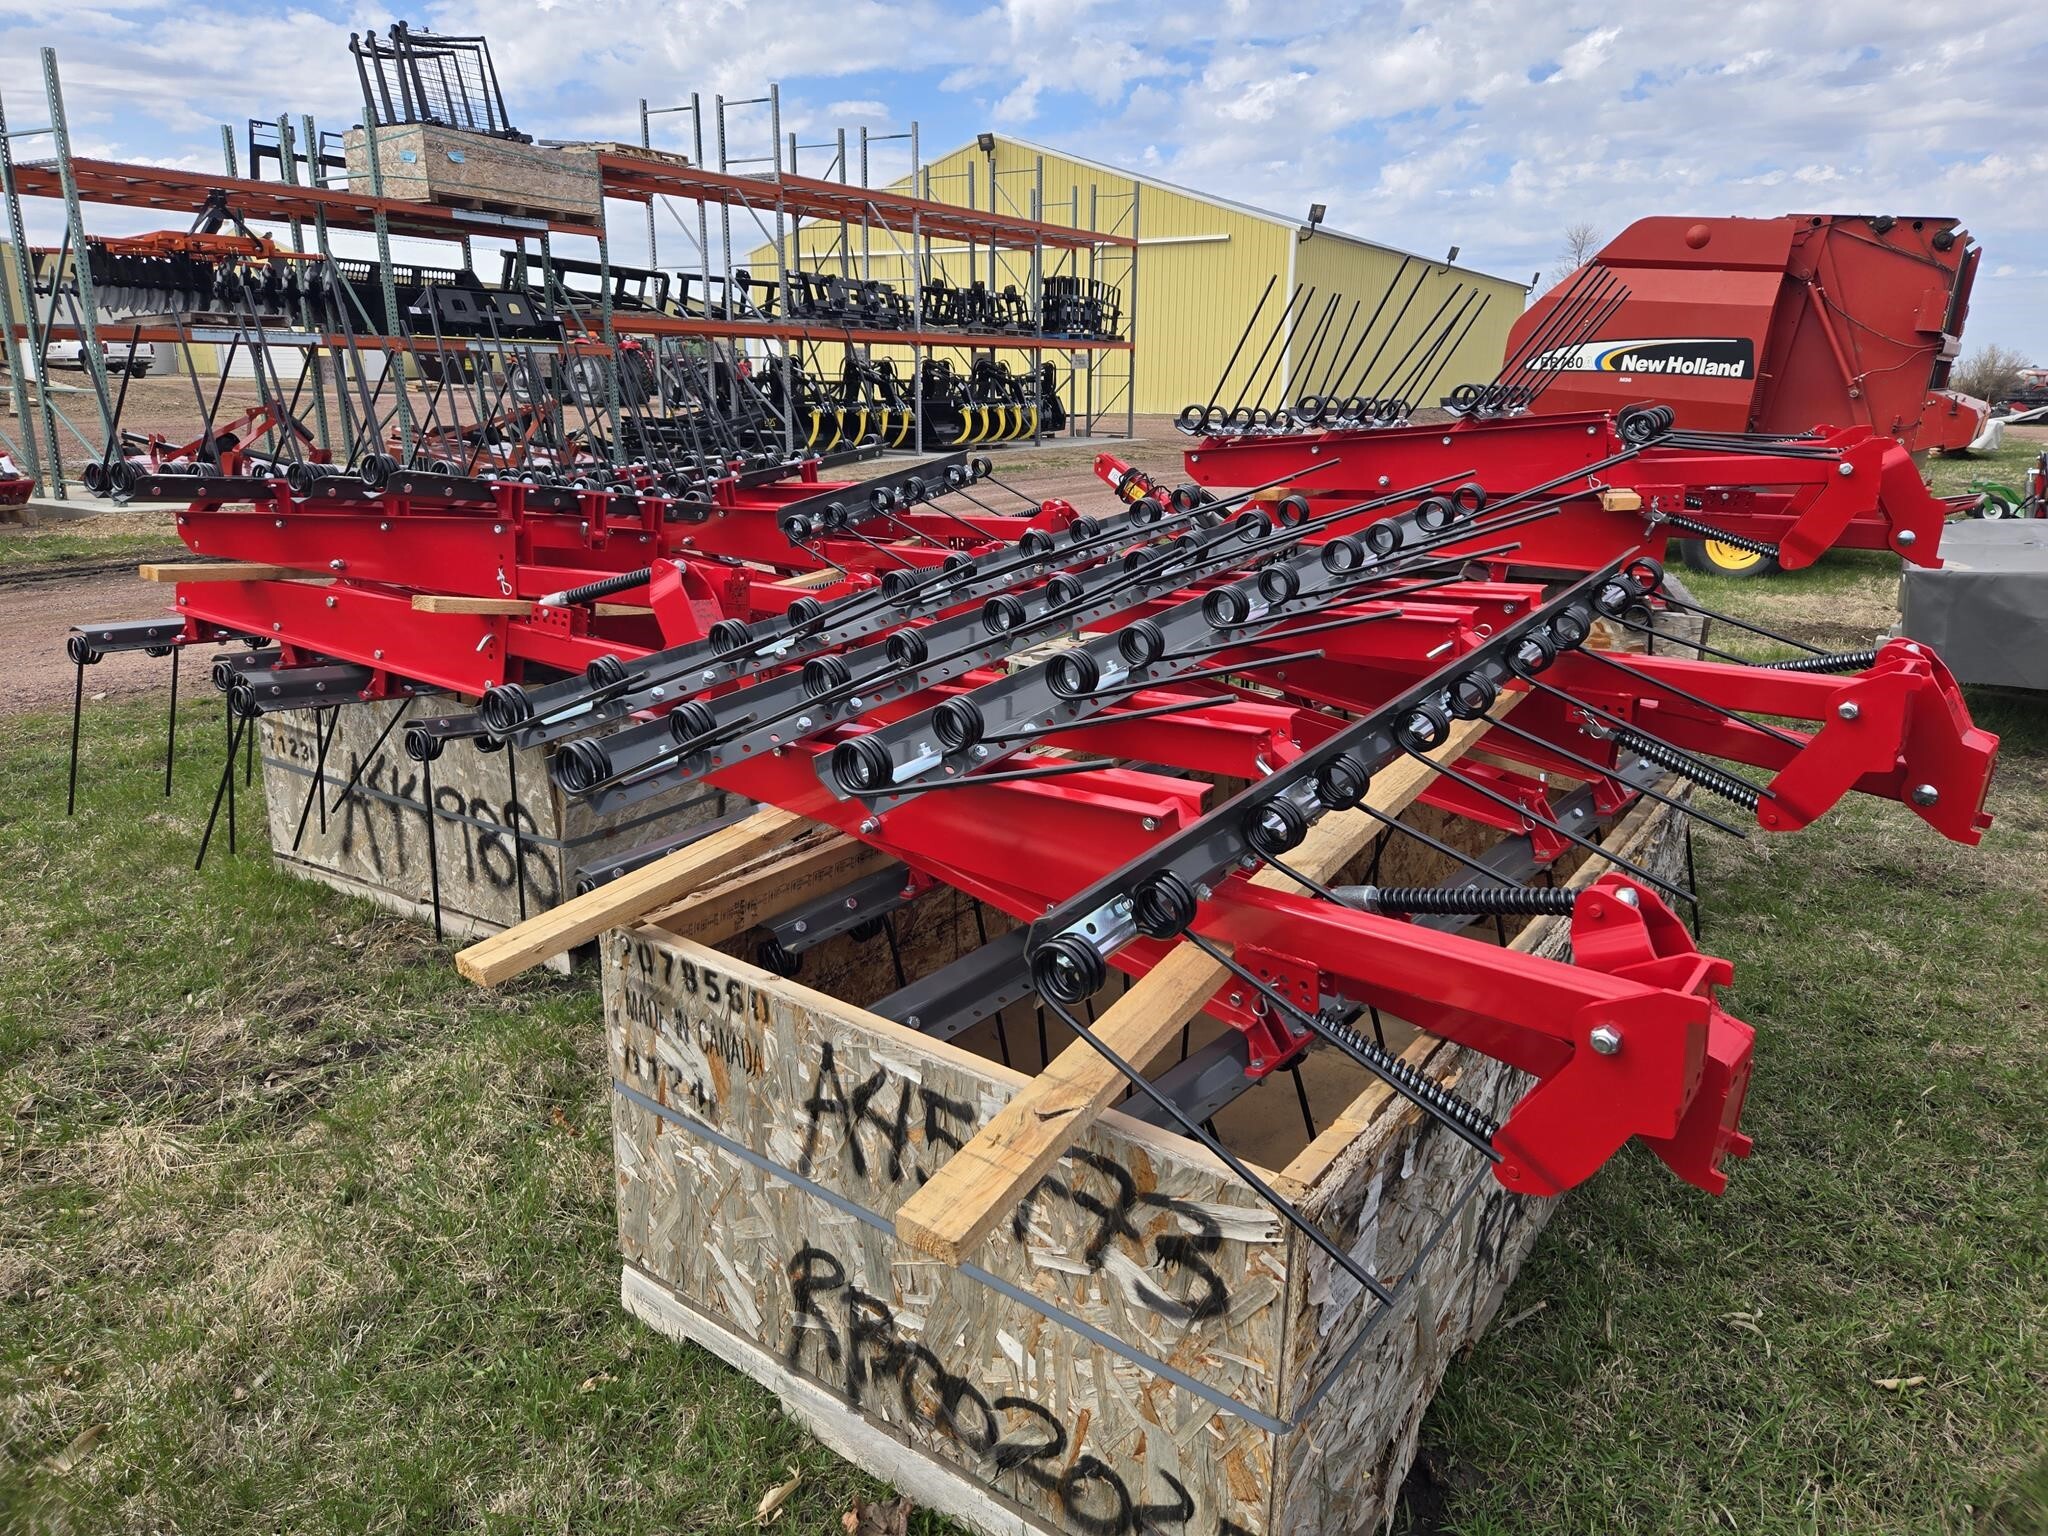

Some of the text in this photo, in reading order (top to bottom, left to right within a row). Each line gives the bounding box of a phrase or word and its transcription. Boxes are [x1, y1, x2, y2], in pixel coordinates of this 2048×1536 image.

[1620, 354, 1745, 378] New Holland
[698, 1018, 766, 1080] CANADA
